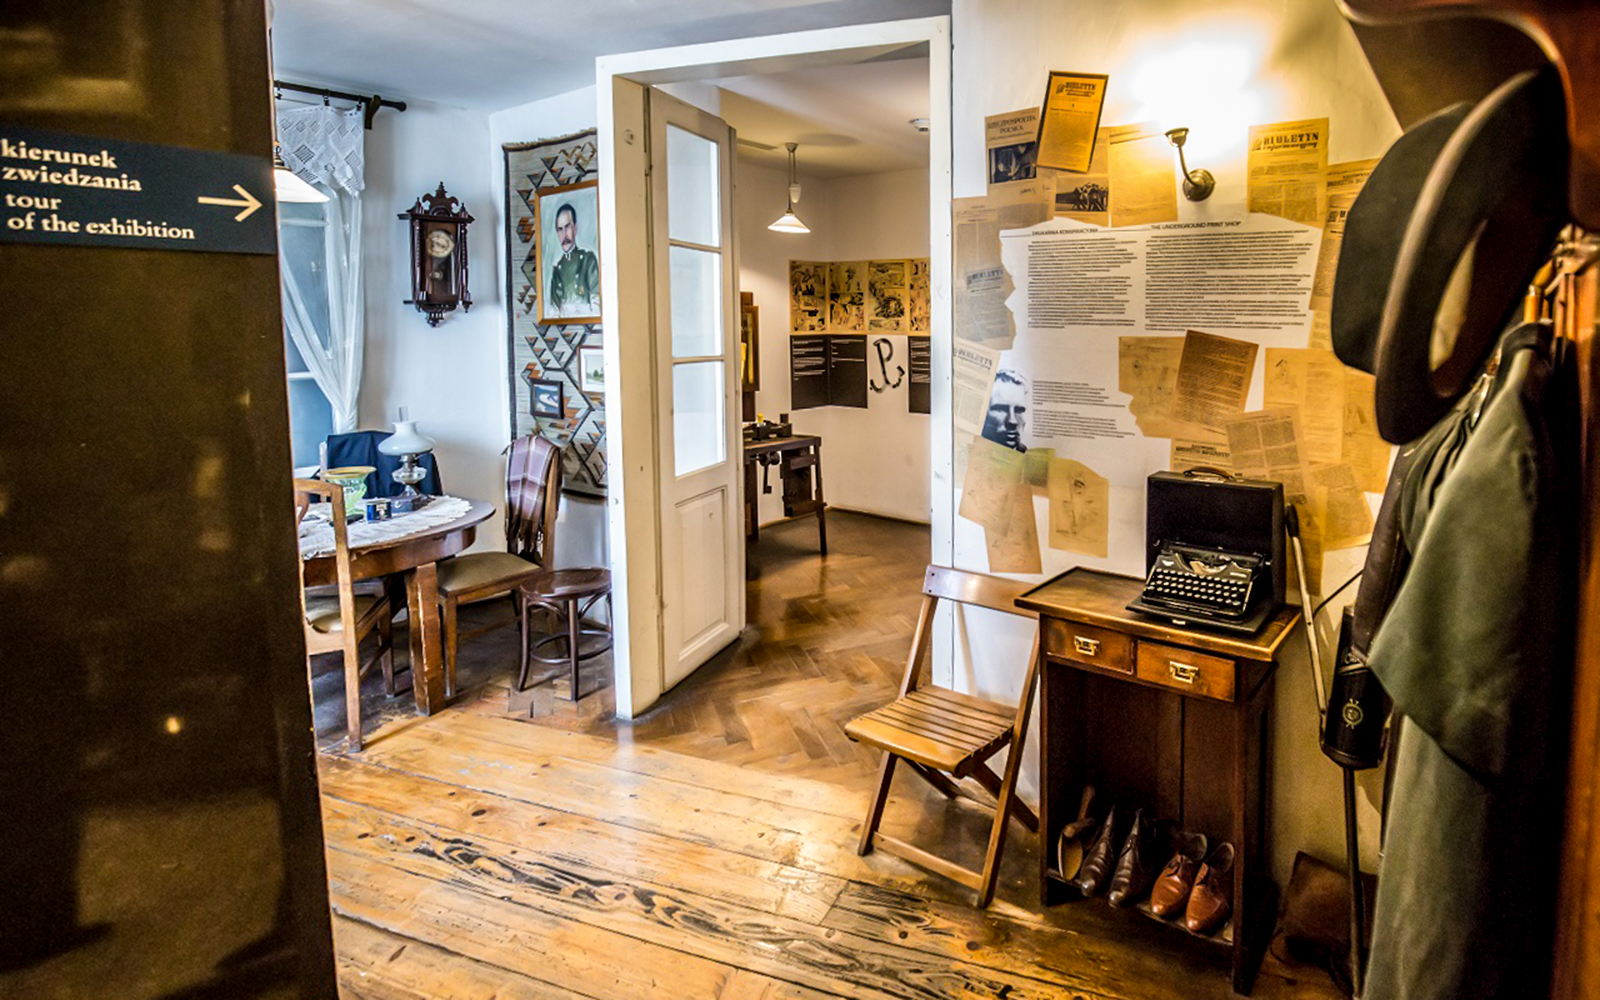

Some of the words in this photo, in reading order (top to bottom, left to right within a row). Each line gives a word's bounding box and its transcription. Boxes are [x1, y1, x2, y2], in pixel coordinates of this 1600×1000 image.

[1263, 132, 1319, 146] BIULETYN
[1, 138, 118, 169] kierunek
[2, 165, 142, 192] zwiedzania
[5, 193, 62, 210] tour
[7, 212, 36, 231] of
[41, 214, 80, 233] the
[86, 217, 196, 240] exhibition
[1162, 222, 1206, 230] UNDERGROUND
[1206, 221, 1224, 229] PRINT
